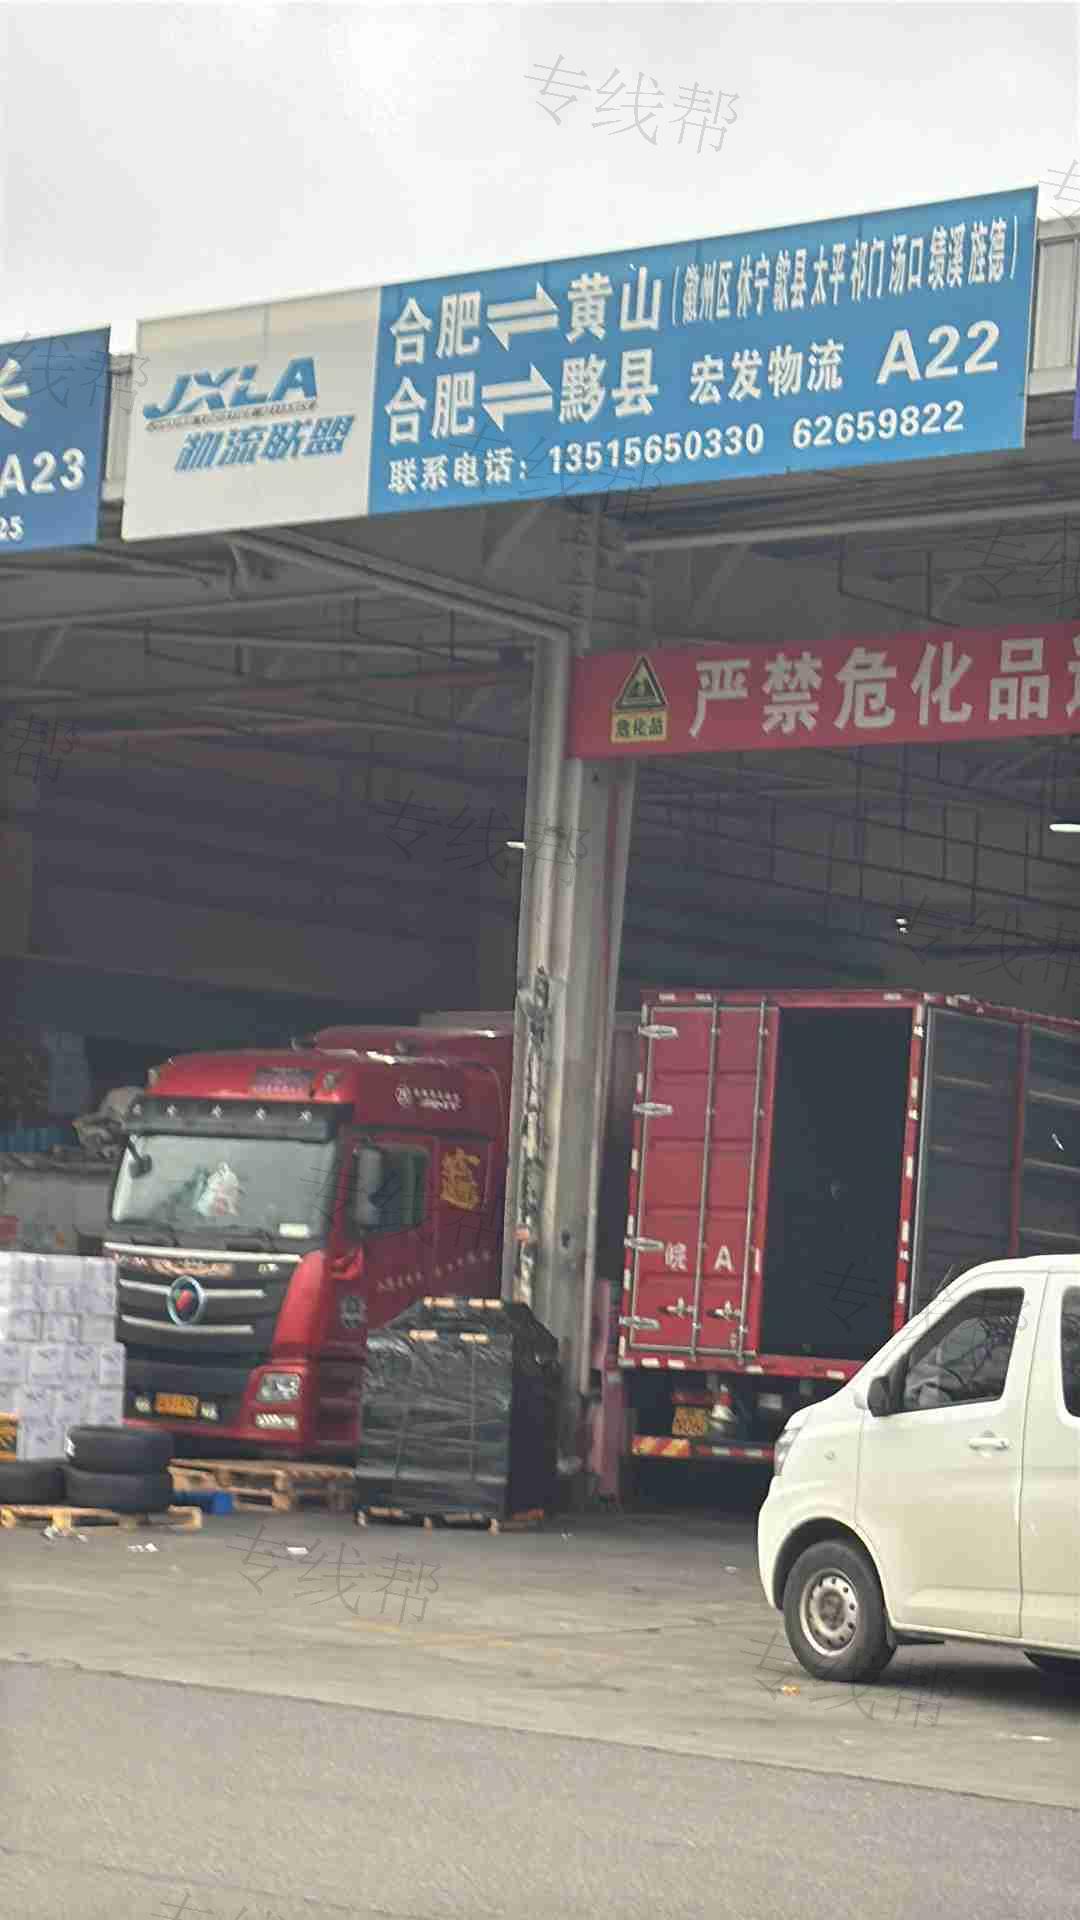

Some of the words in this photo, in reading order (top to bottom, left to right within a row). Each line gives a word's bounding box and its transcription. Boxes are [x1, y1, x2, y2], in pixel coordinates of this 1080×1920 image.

[389, 291, 481, 366] 合肥
[565, 266, 663, 344] 黄山
[143, 356, 318, 420] JXLA
[384, 371, 476, 446] 合肥
[558, 348, 660, 424] 黟县
[689, 338, 845, 404] 宏发物流
[876, 320, 1000, 385] A22
[174, 415, 355, 473] 物流联盟
[549, 423, 765, 475] 13515650330
[793, 400, 964, 449] 62659822
[0, 447, 86, 498] A23
[689, 631, 1080, 738] 严禁危化品
[615, 717, 664, 737] 危化品
[714, 1244, 734, 1272] A
